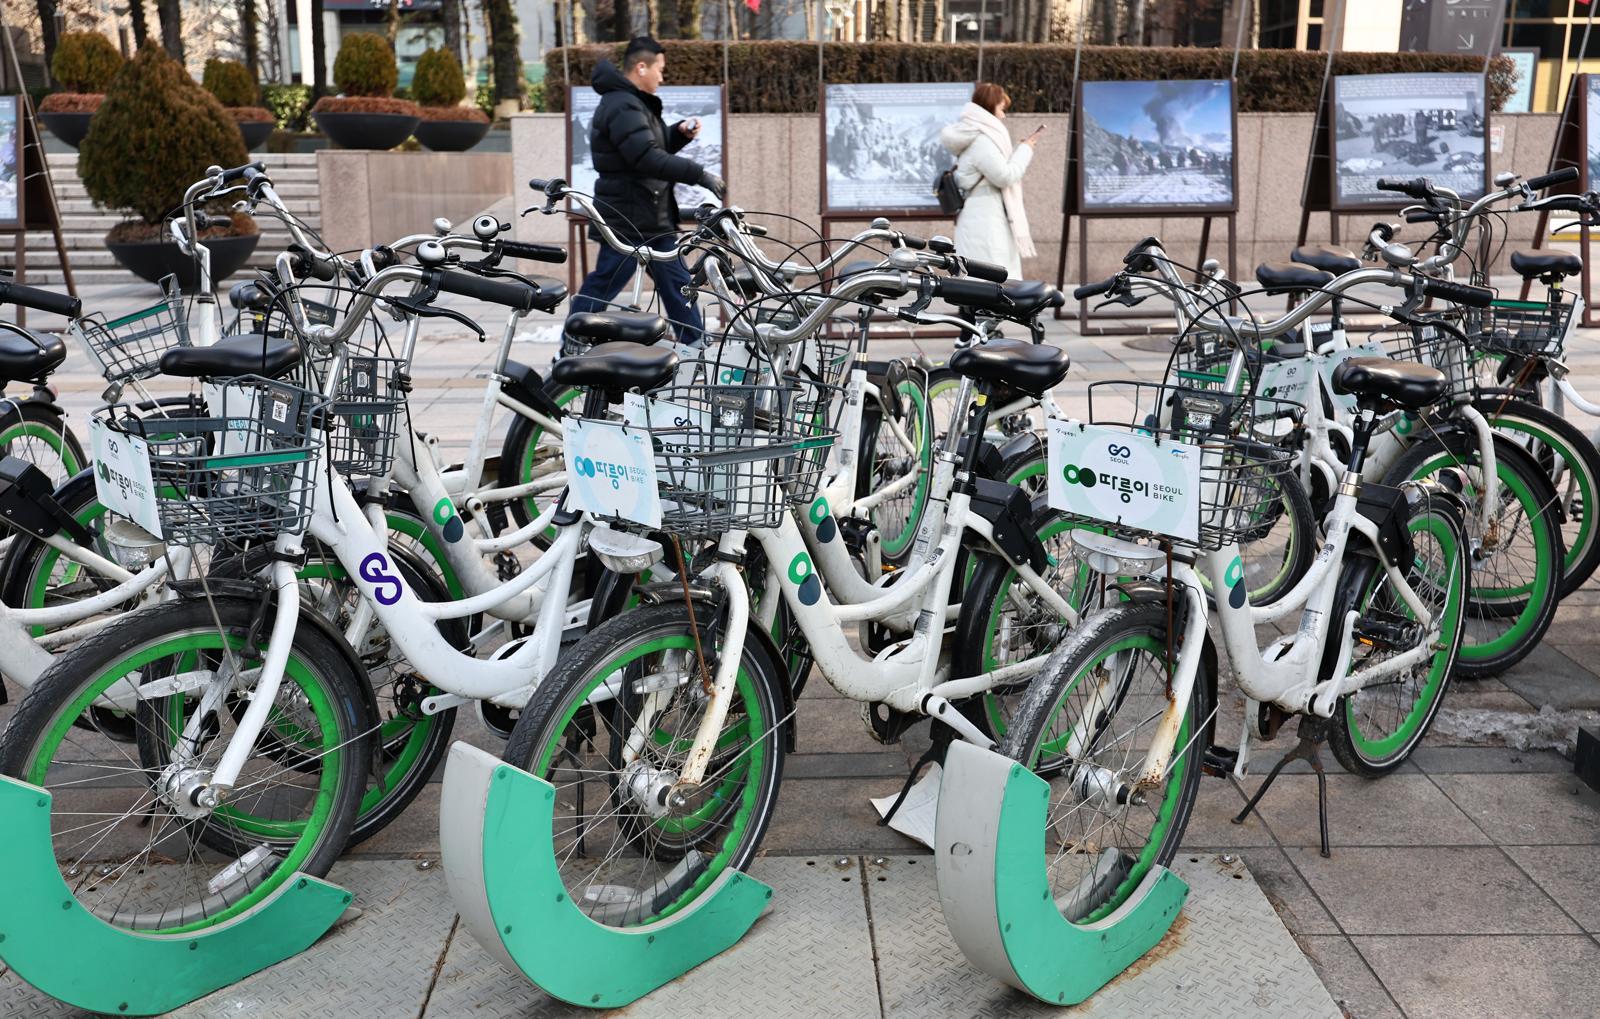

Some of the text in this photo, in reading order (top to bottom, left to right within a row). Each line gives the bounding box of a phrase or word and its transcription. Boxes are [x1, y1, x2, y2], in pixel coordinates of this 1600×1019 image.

[1109, 456, 1129, 465] SEOUL
[110, 468, 133, 500] 따릉이
[595, 461, 629, 490] 따릉이
[1099, 473, 1149, 504] 따릉이
[1153, 483, 1183, 496] SEOUL
[1153, 493, 1174, 503] BIKE
